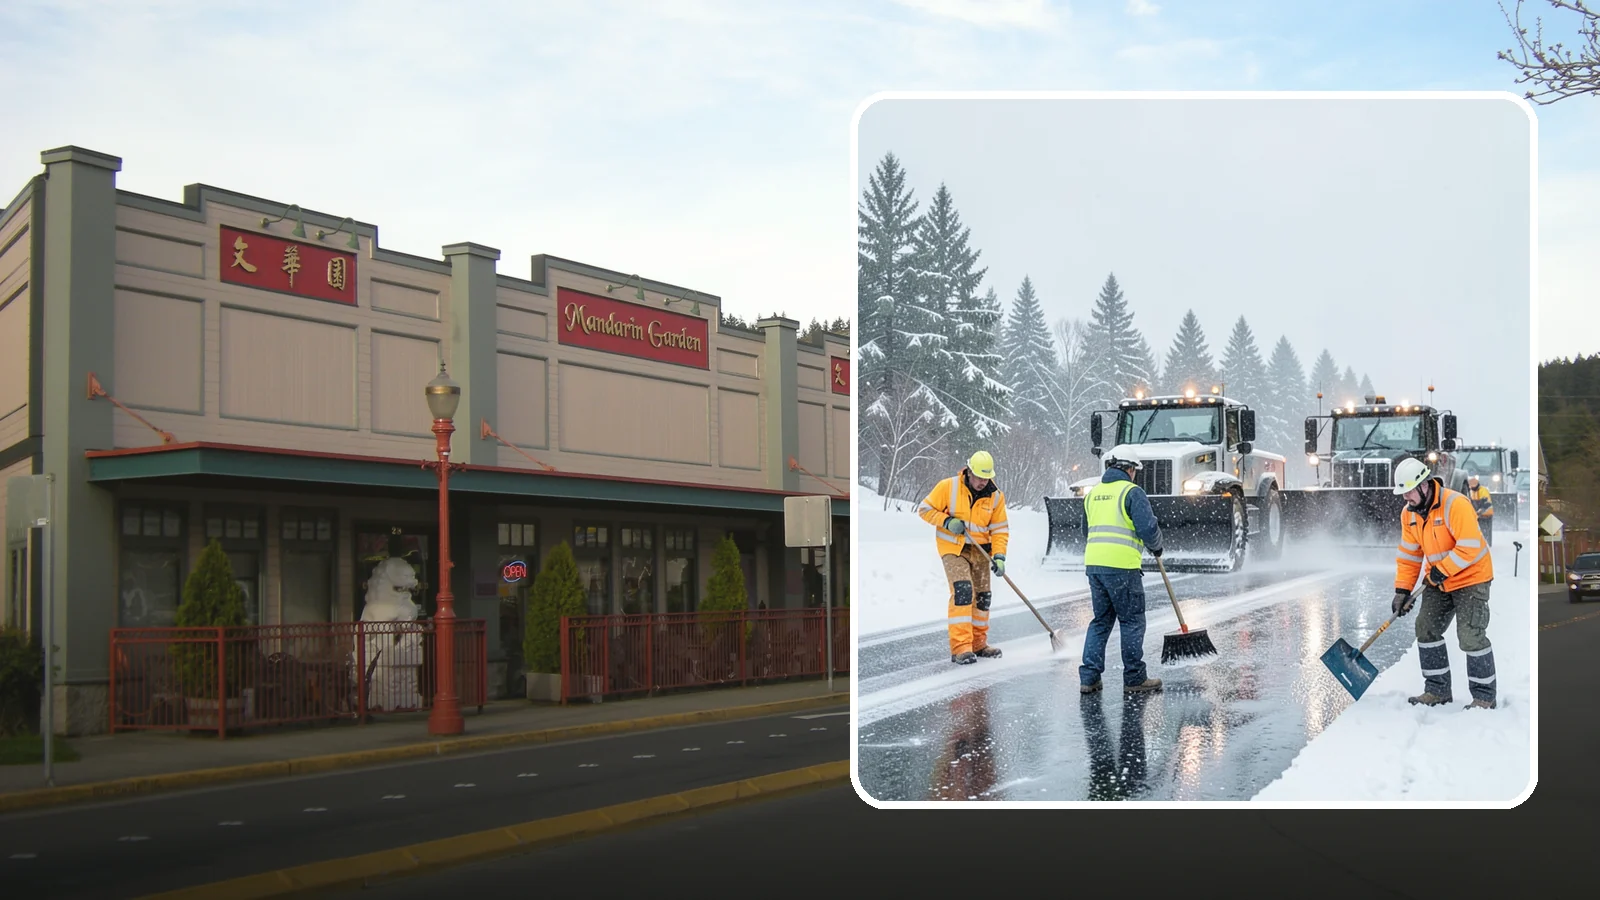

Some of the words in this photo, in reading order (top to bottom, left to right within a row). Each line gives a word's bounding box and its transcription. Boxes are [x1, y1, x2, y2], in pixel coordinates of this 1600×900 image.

[231, 235, 346, 290] 文華園
[564, 302, 644, 341] Mandarin
[647, 320, 701, 352] Garden
[503, 565, 527, 578] OPEN
